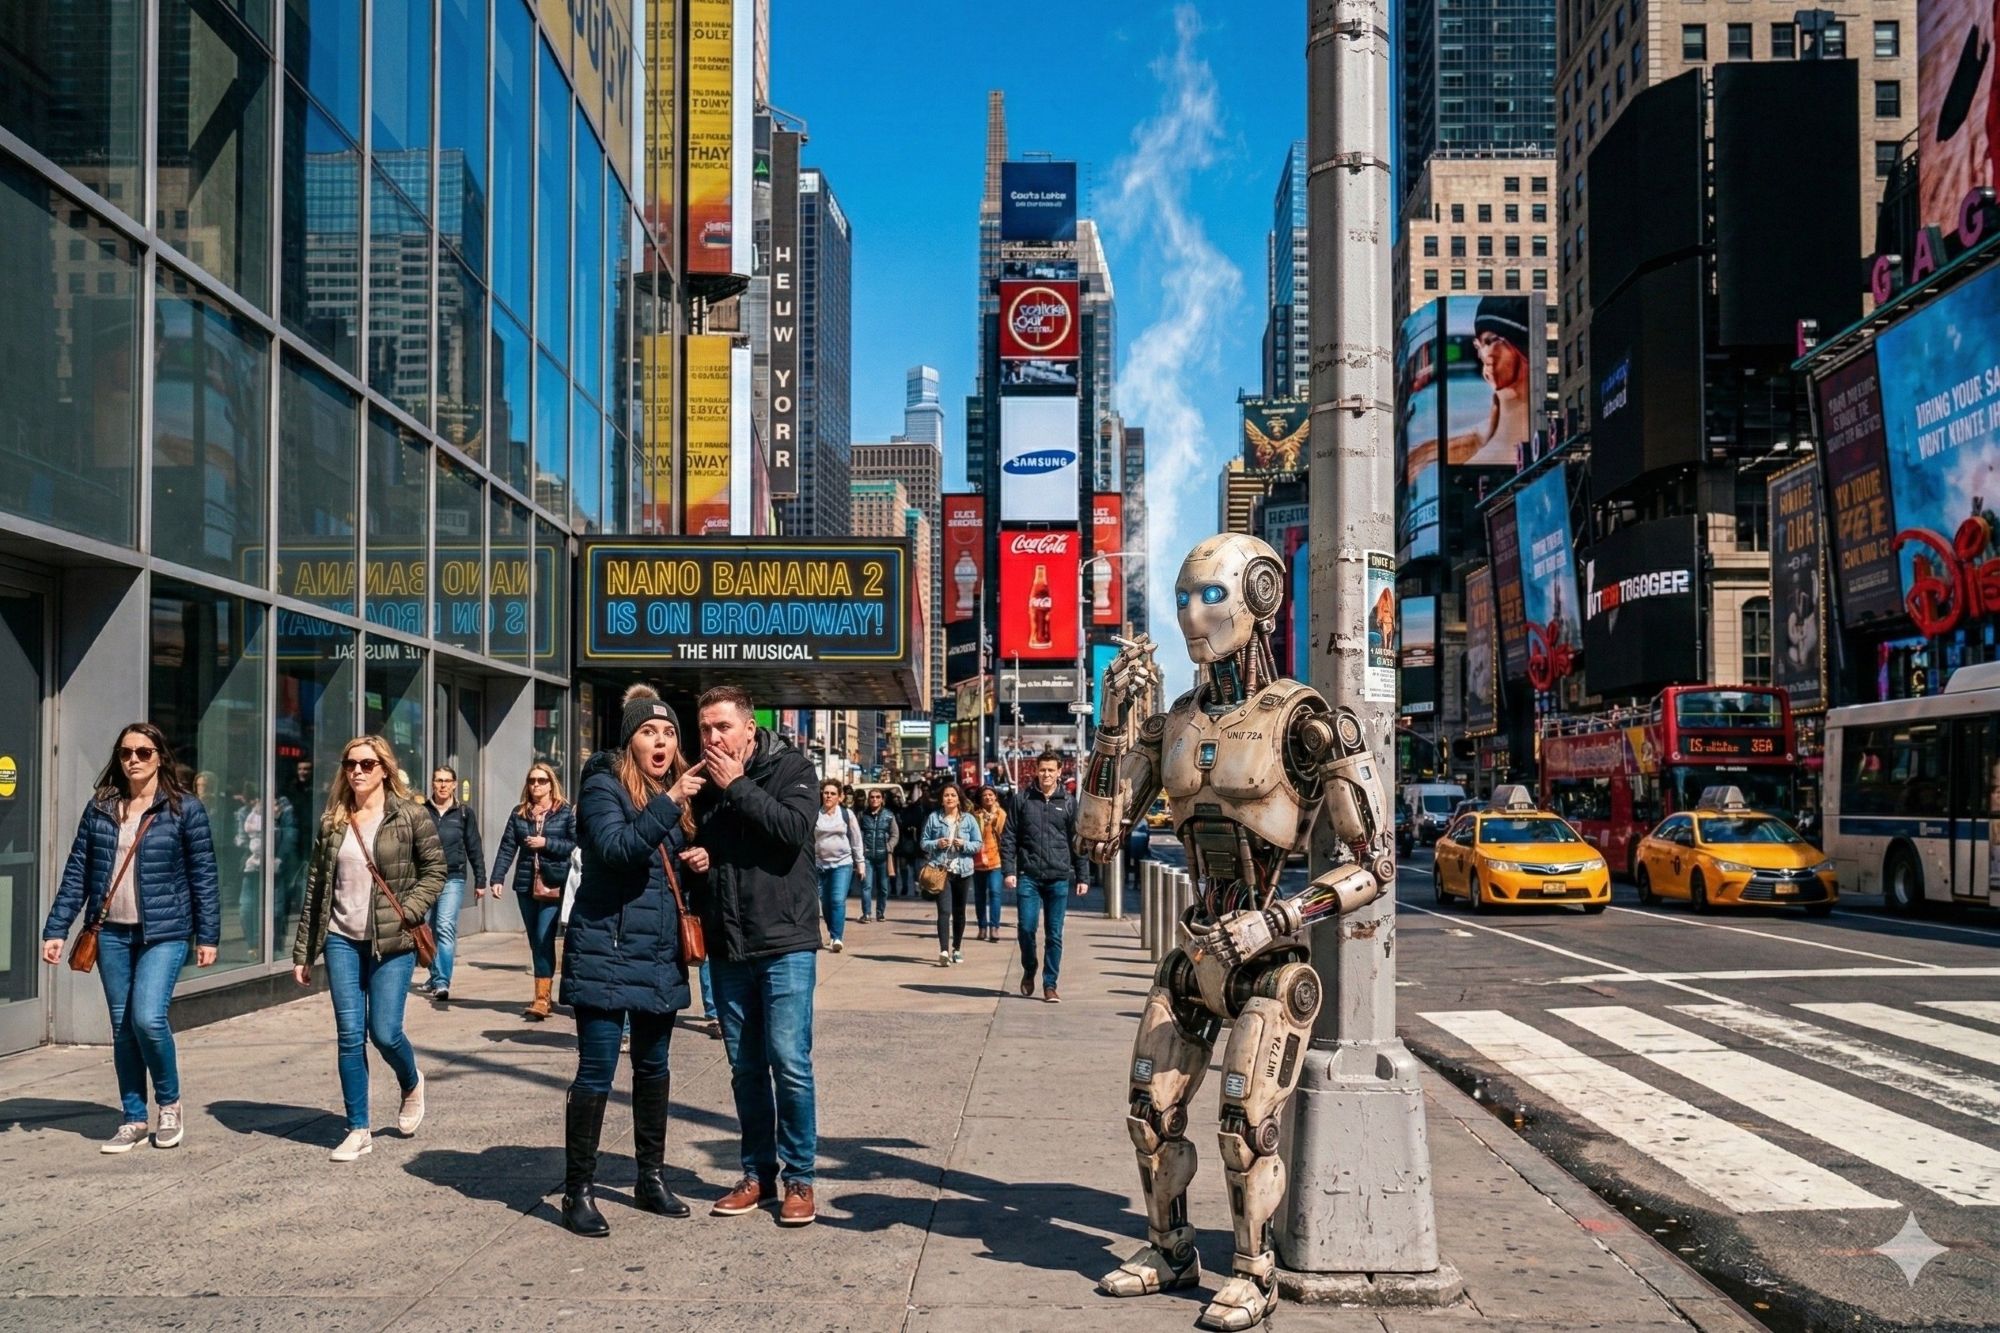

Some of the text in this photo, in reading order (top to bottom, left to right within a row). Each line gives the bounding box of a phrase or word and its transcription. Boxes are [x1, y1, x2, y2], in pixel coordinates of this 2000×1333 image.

[1951, 374, 1983, 412] YOUR
[1012, 457, 1067, 467] SAMSUNG
[606, 561, 884, 596] NANO BANANA 2
[607, 602, 884, 636] IS ON BROADWAY!
[678, 644, 813, 661] THE HIT MUSICAL
[1227, 731, 1263, 740] UNIT 72A
[1269, 1036, 1282, 1057] 72A
